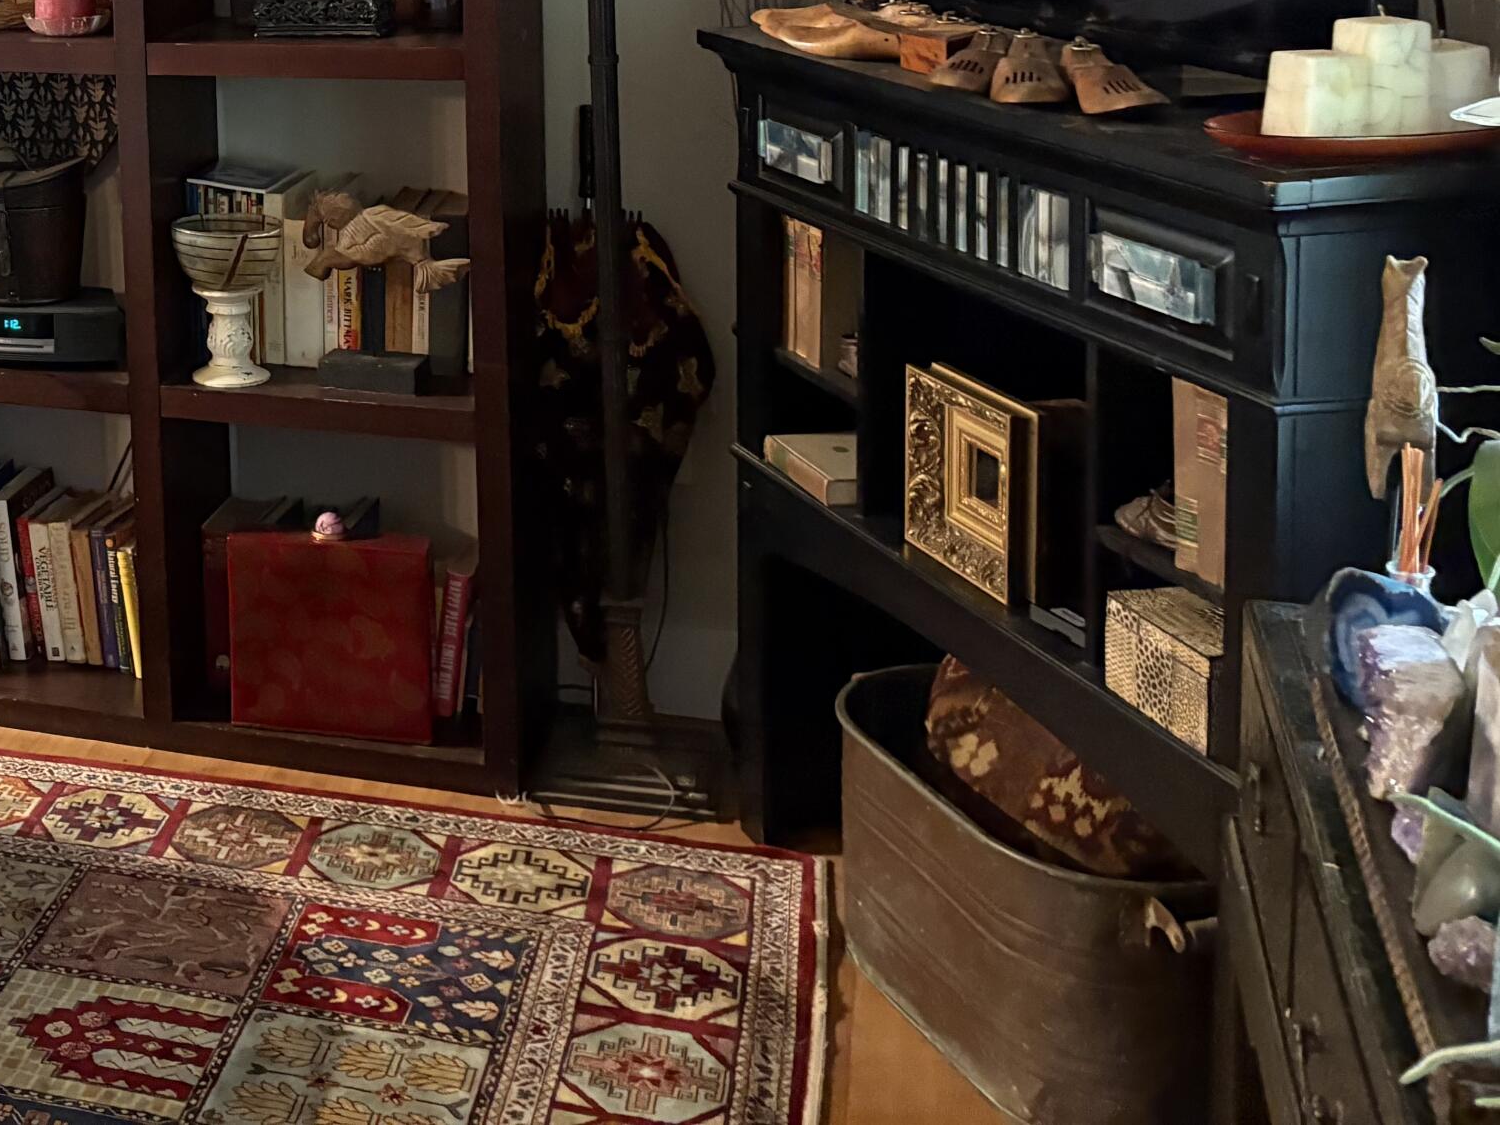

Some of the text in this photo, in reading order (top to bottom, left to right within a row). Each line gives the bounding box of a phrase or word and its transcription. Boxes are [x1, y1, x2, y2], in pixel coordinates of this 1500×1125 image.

[343, 276, 352, 305] MARK
[38, 546, 55, 612] VEGETABLE
[107, 550, 119, 604] Natural Energy
[447, 580, 462, 608] HAPPY
[444, 610, 459, 636] PLACE
[440, 643, 456, 670] EMILY
